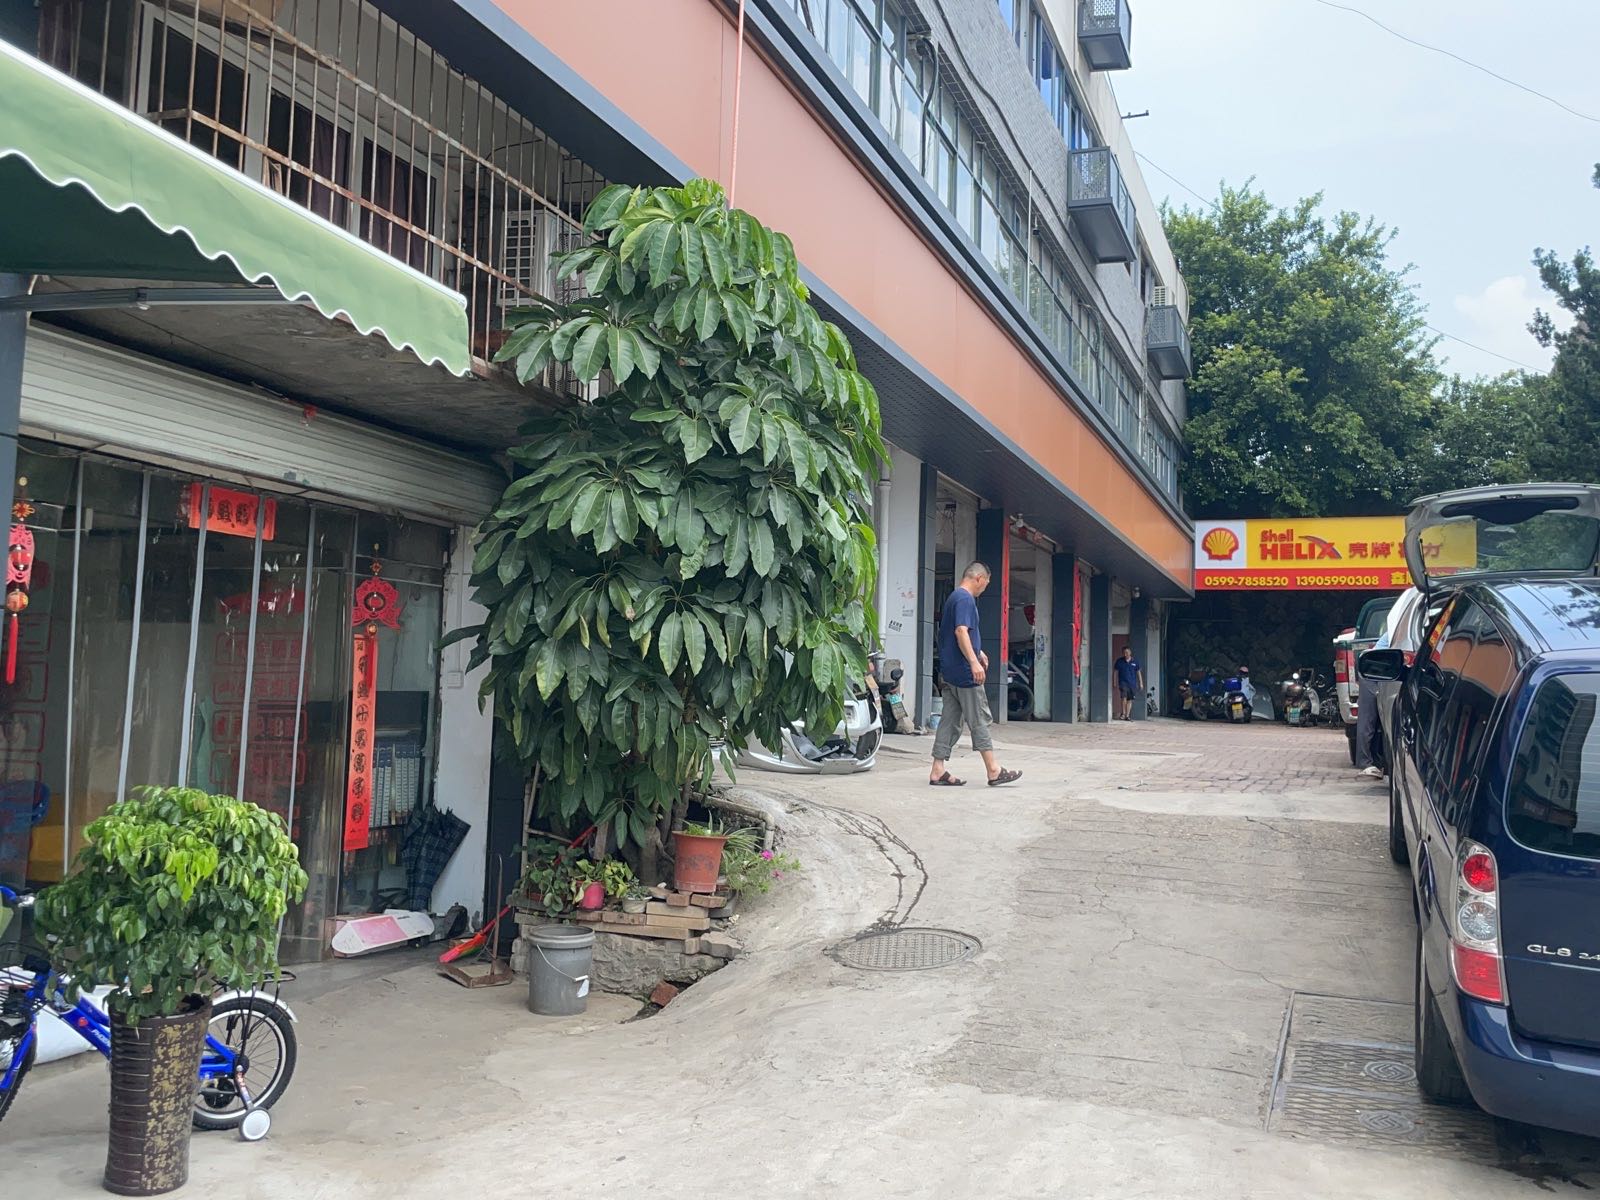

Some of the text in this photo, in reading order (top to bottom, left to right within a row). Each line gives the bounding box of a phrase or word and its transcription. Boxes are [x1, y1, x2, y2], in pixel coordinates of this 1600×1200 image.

[1260, 528, 1294, 542] Shell
[1259, 543, 1338, 560] HELIX
[1204, 575, 1380, 587] 0599-7858520 13905990308
[1526, 944, 1572, 957] GL8
